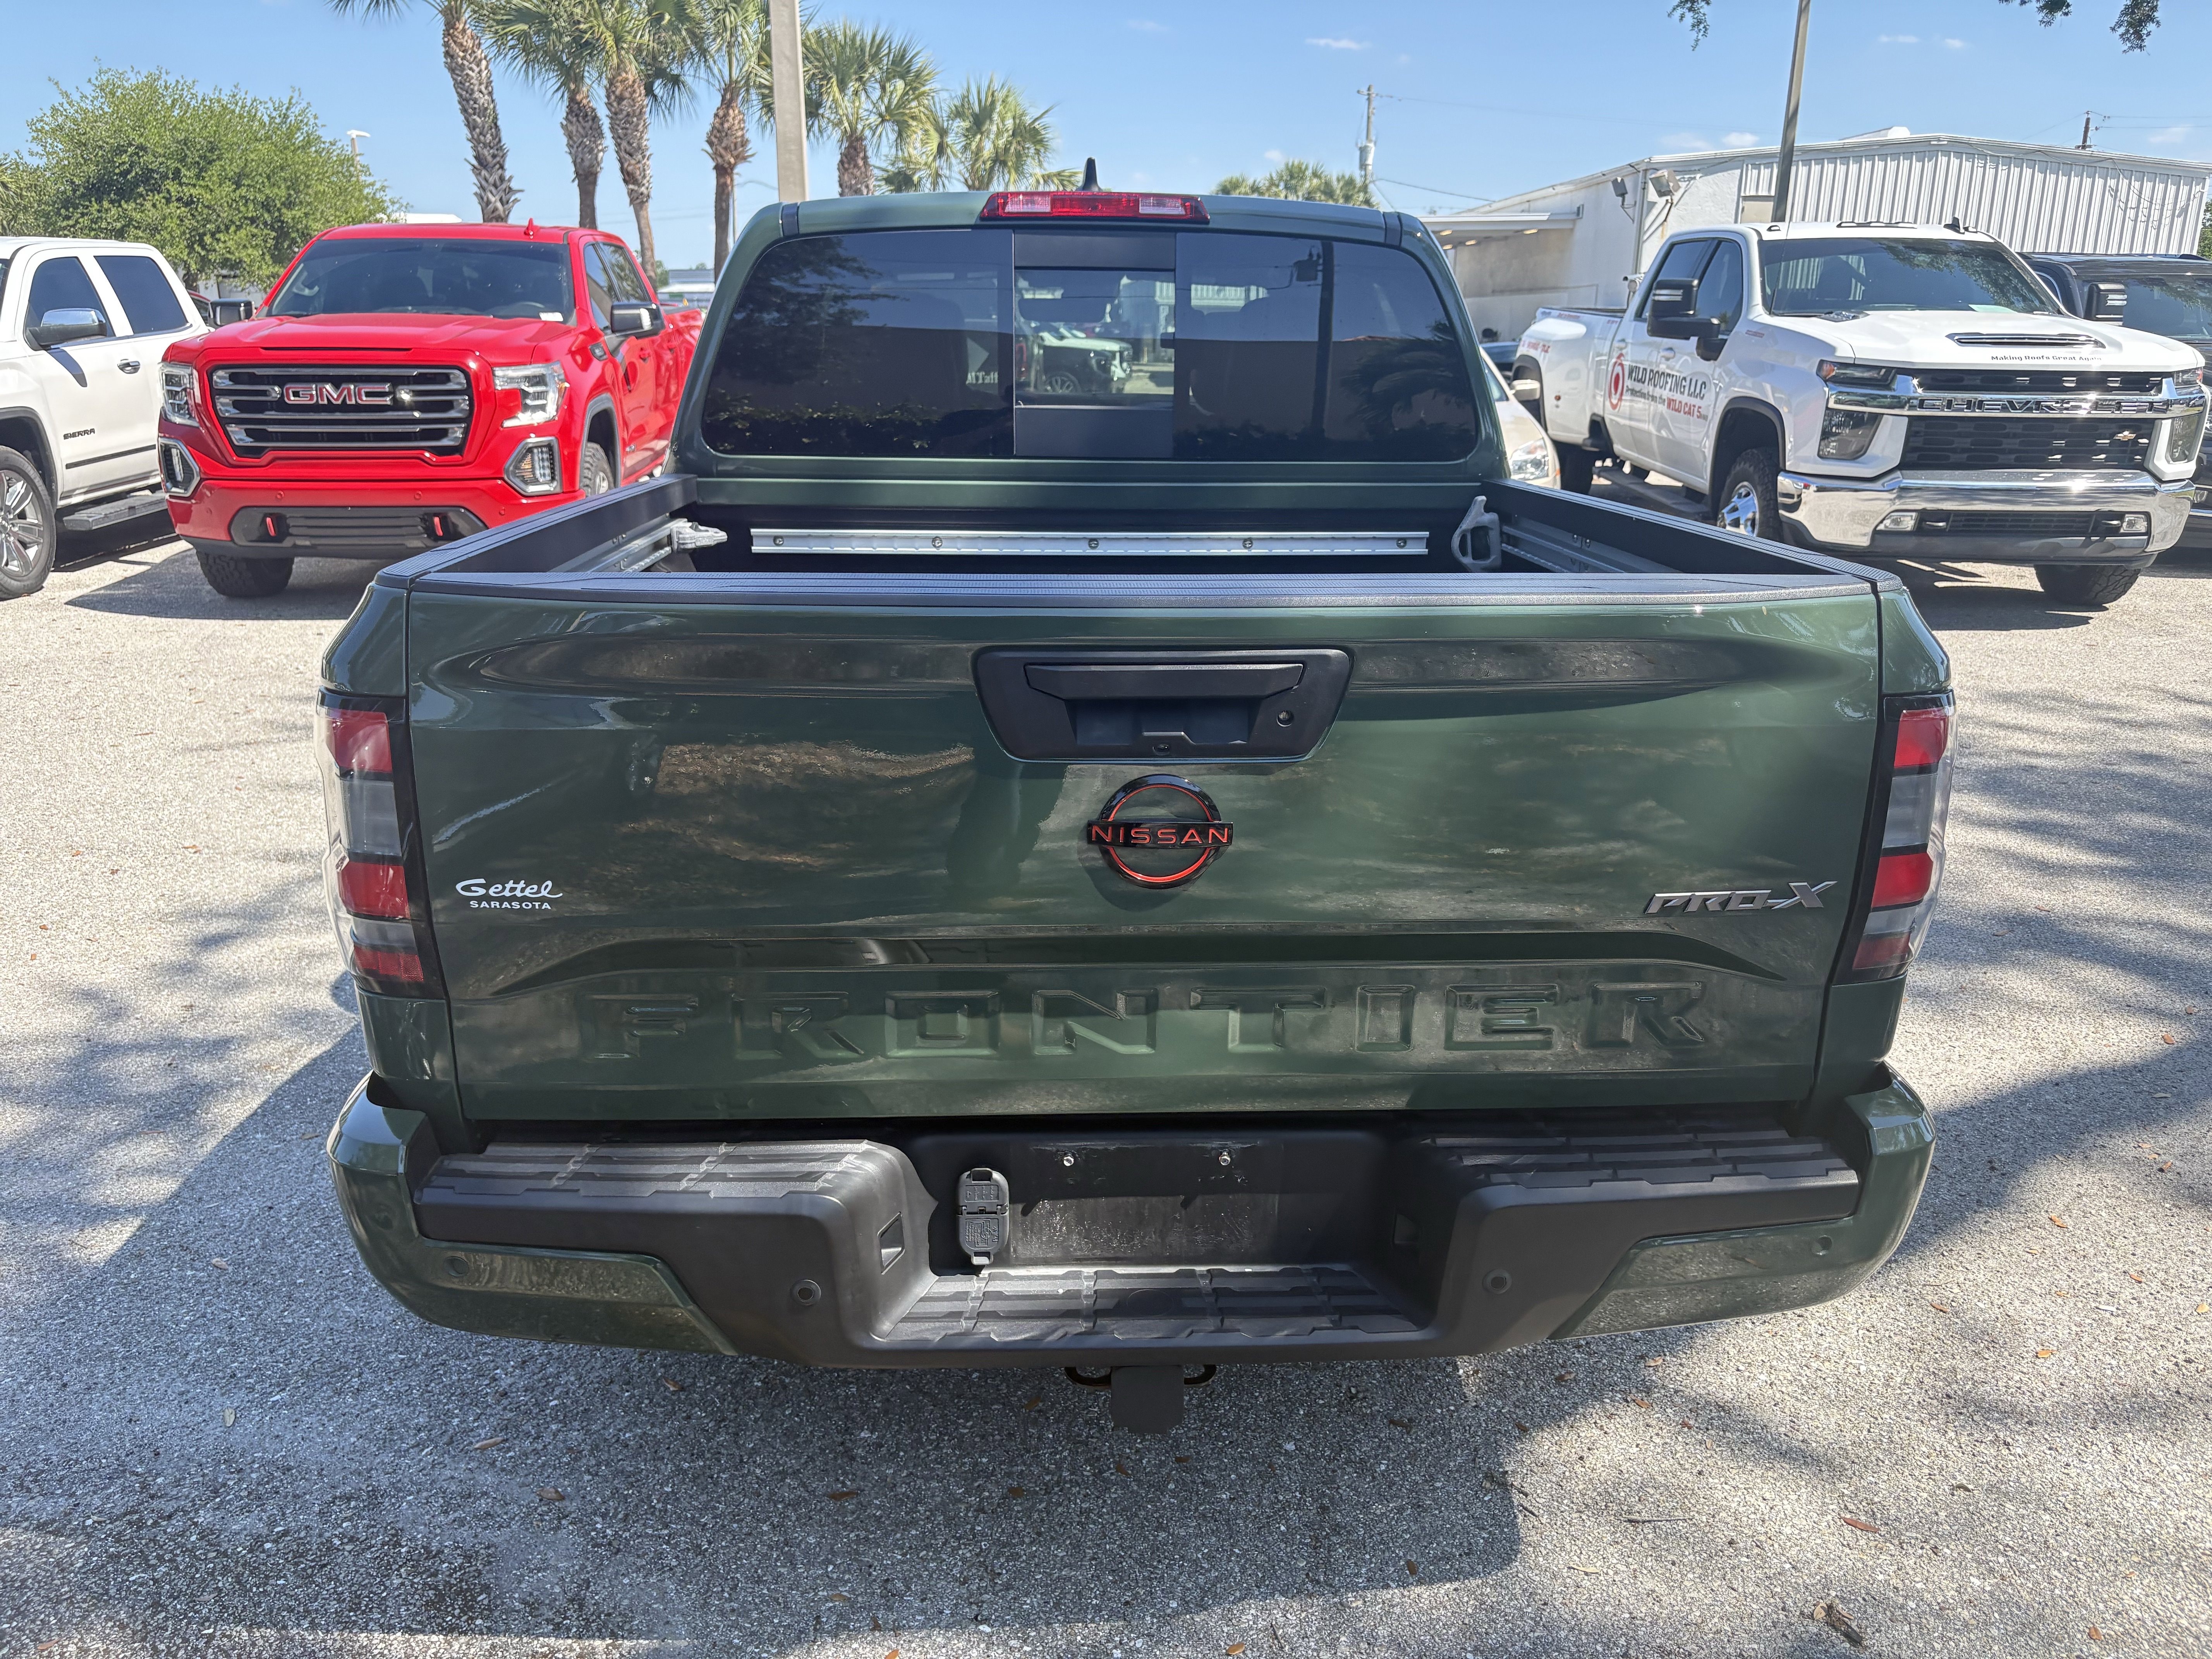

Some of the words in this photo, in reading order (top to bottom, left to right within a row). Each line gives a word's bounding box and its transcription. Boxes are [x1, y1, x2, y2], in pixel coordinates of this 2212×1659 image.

[1627, 364, 1647, 385] WILD
[1647, 369, 1686, 395] ROOFING
[1687, 378, 1706, 400] LLC
[284, 383, 393, 405] GMC
[1666, 397, 1682, 414] WILD
[1683, 402, 1696, 418] CAT
[1917, 398, 2165, 414] CHEVROLET
[63, 428, 95, 440] SIERRA
[1092, 825, 1228, 844] NISSAN
[456, 878, 563, 898] Gettel
[1645, 881, 1838, 914] PRO-X
[470, 900, 551, 909] SARASOTA
[583, 981, 1707, 1061] FRONTIER
